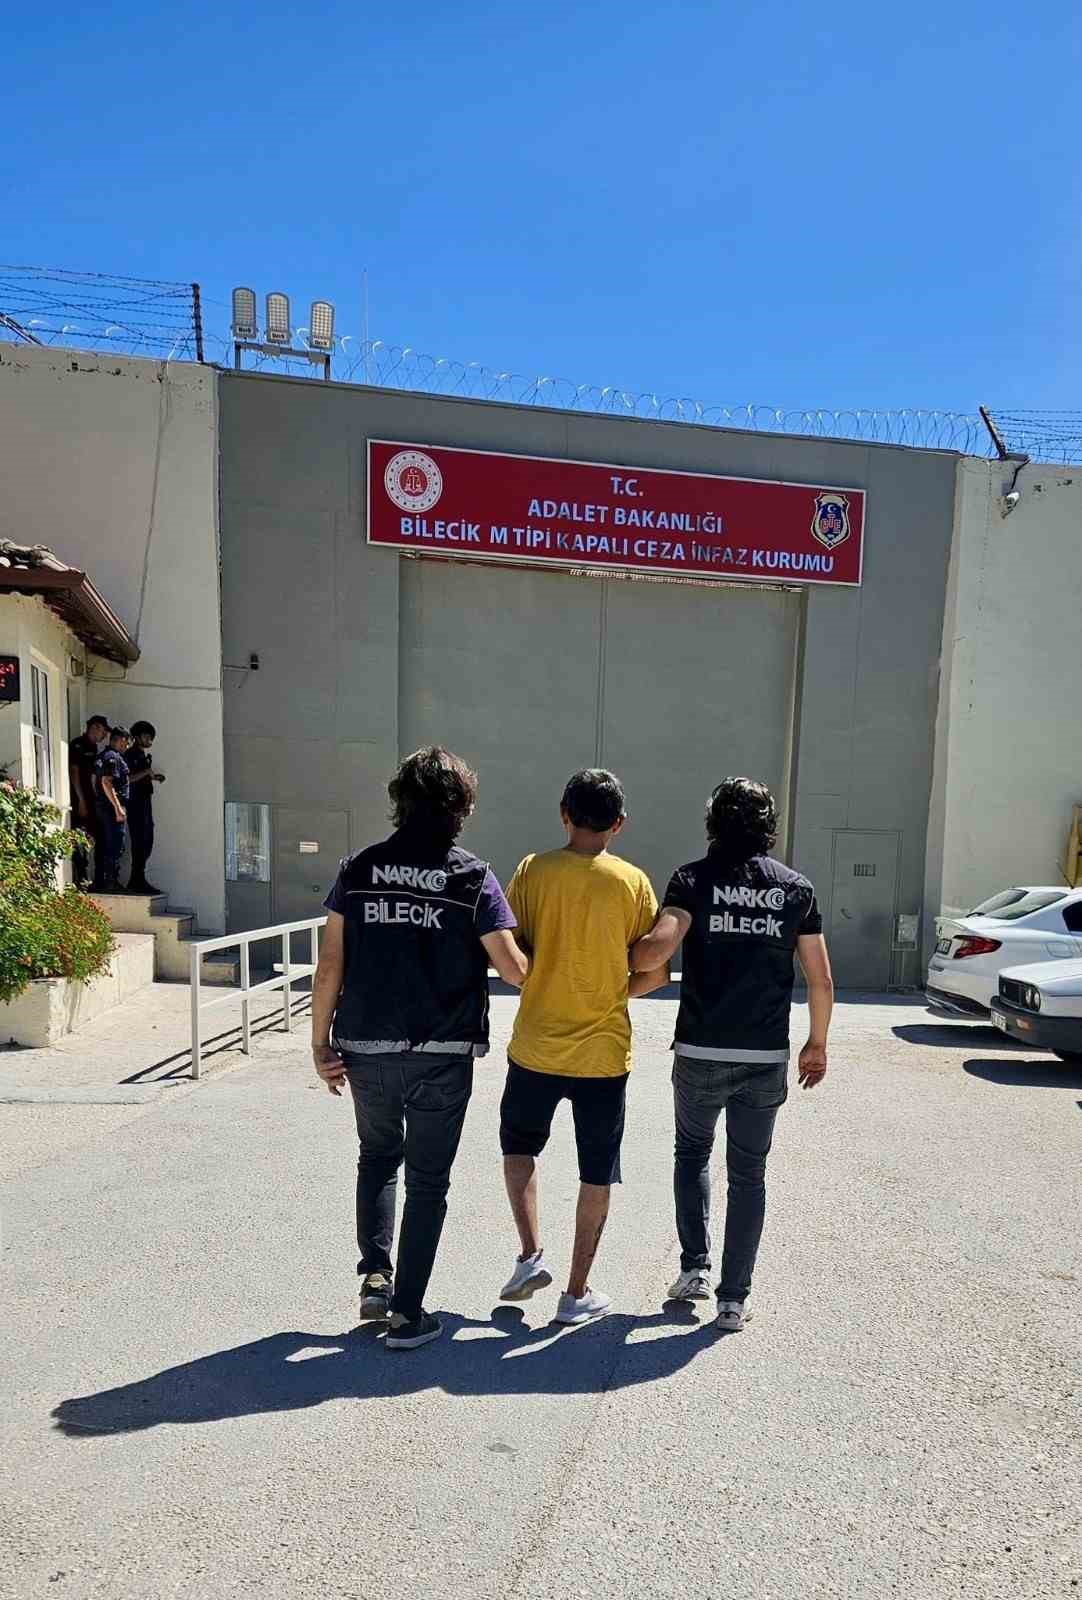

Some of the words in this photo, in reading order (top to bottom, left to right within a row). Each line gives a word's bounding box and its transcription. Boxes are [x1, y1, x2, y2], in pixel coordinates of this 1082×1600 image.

[610, 476, 644, 497] T.C.
[527, 498, 609, 524] ADALET
[614, 506, 723, 534] BAKANLIĞI
[400, 514, 481, 542] BİLECİK
[489, 525, 508, 545] M
[512, 524, 551, 549] TİPİ
[556, 532, 628, 556] KAPALI
[633, 539, 685, 561] CEZA
[690, 540, 747, 566] İNFAZ
[752, 549, 834, 573] KURUMU
[364, 898, 444, 929] BİLECİK
[709, 911, 784, 938] BİLECİK
